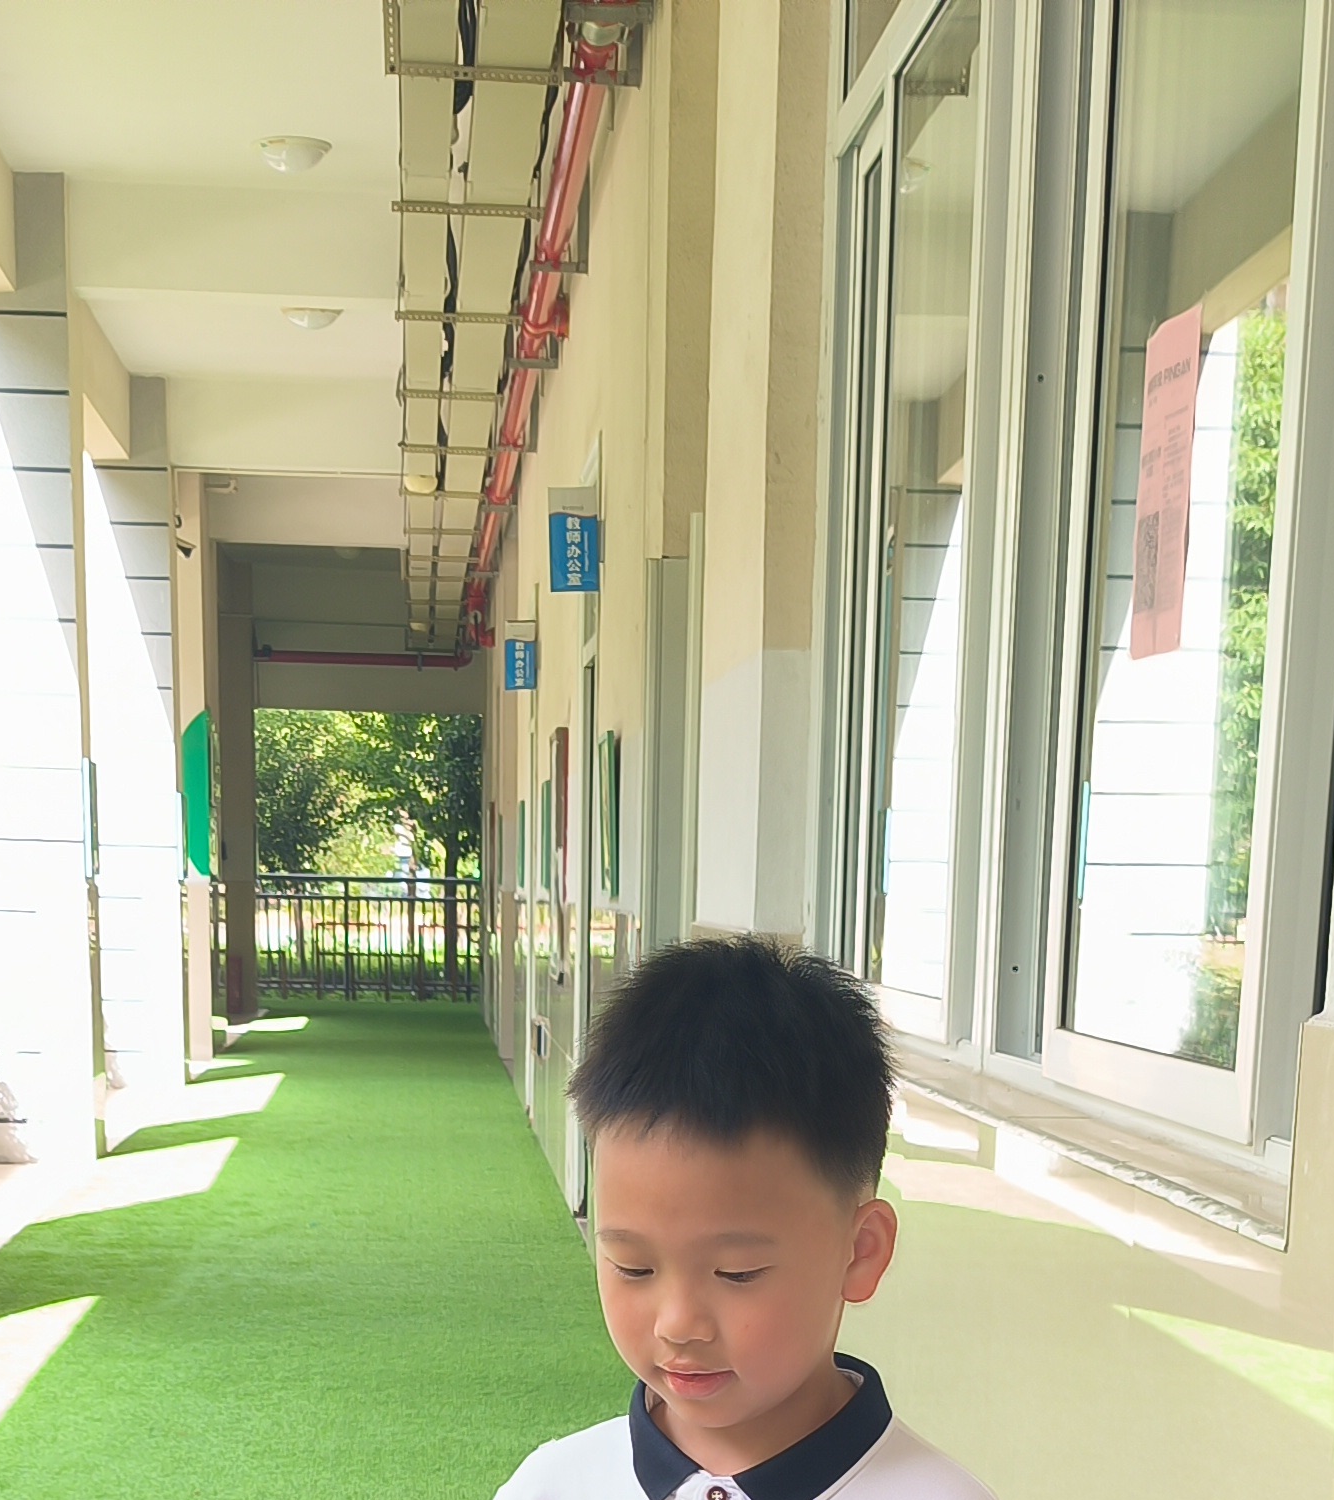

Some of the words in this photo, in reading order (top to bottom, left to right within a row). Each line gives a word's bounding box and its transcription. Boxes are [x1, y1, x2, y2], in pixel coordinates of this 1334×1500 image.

[566, 516, 582, 586] 教师办公室
